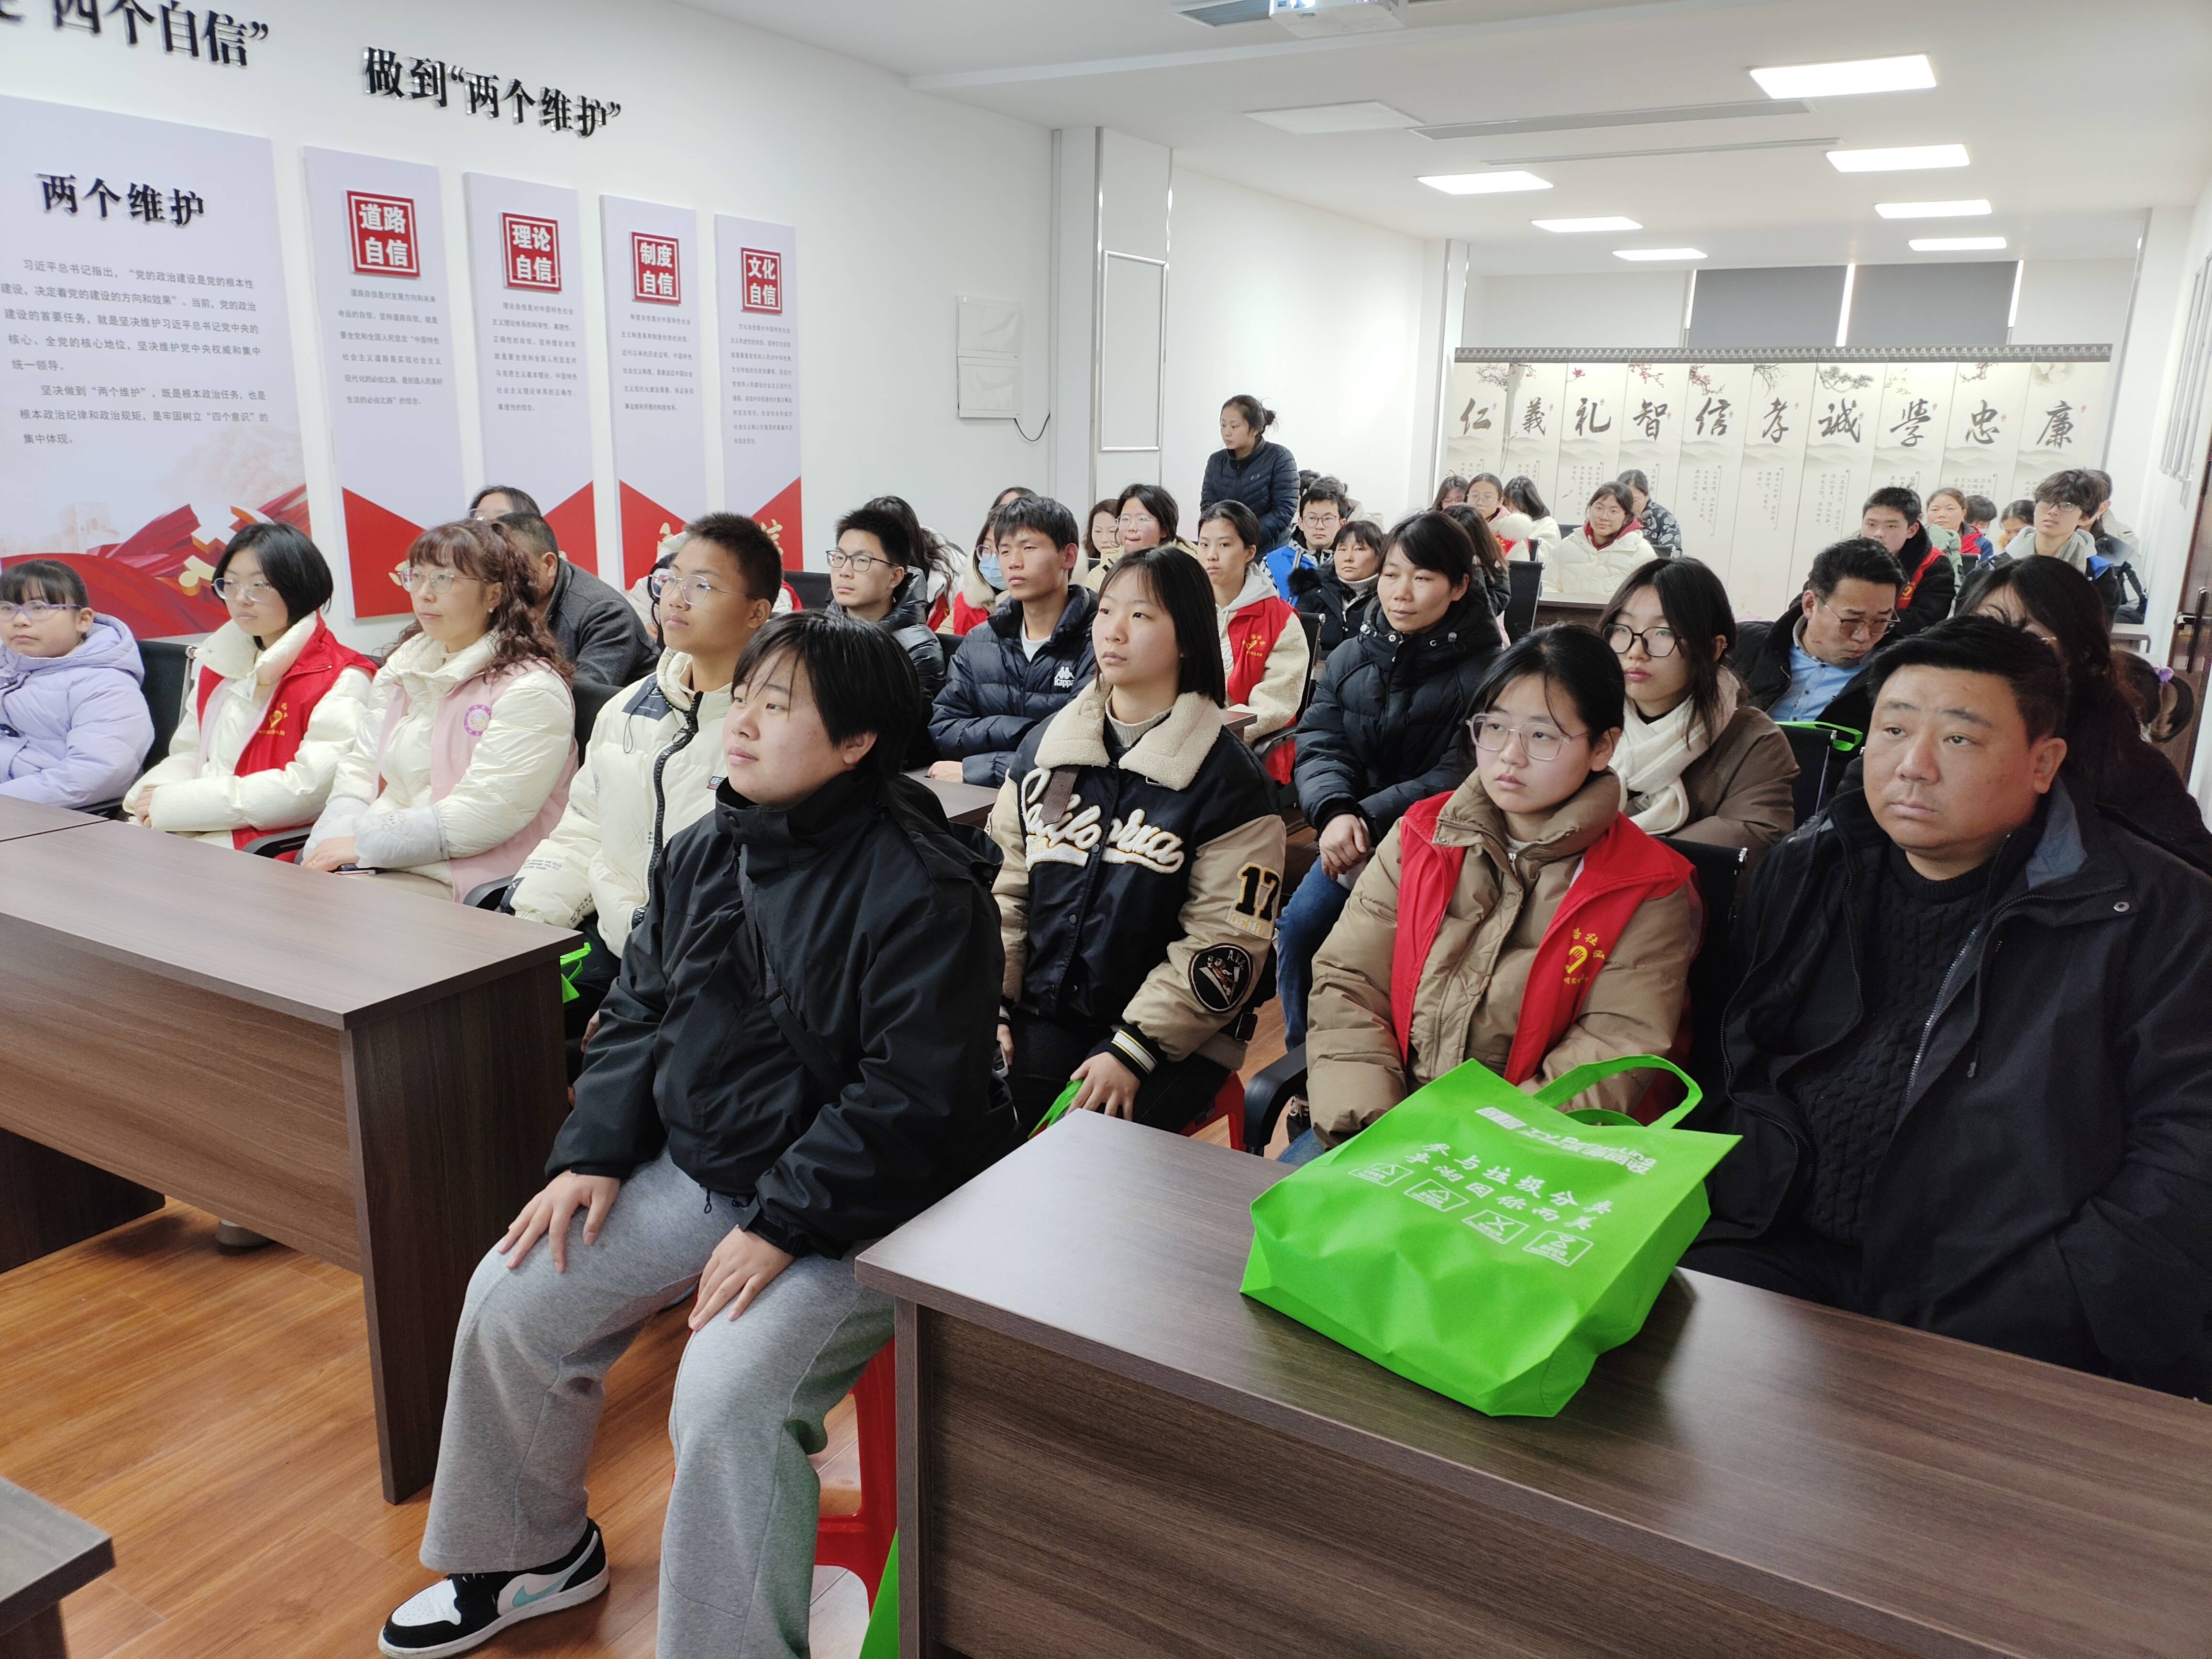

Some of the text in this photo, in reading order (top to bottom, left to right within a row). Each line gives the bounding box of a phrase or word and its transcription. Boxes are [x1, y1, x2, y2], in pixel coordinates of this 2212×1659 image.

[364, 46, 621, 138] 做到“两个维护”
[37, 173, 204, 226] 两个维护
[359, 203, 406, 234] 道路
[365, 236, 408, 267] 自信
[512, 224, 551, 252] 理论
[516, 254, 552, 281] 自信
[640, 243, 673, 268] 制度
[748, 257, 775, 279] 文化
[642, 270, 674, 295] 自信
[750, 283, 776, 306] 自信
[11, 360, 64, 371] 统一领导。
[1460, 398, 1492, 435] 仁
[1575, 398, 1612, 437] 礼
[1633, 399, 1669, 441] 智
[1696, 397, 1732, 436] 信
[1762, 397, 1789, 443] 孝
[1966, 400, 2000, 444] 忠
[2036, 400, 2074, 448] 廉
[24, 434, 73, 444] 集中体现。
[1054, 678, 1074, 688] Kappa
[1235, 866, 1280, 921] 17
[1421, 1143, 1613, 1214] 参与垃圾分类
